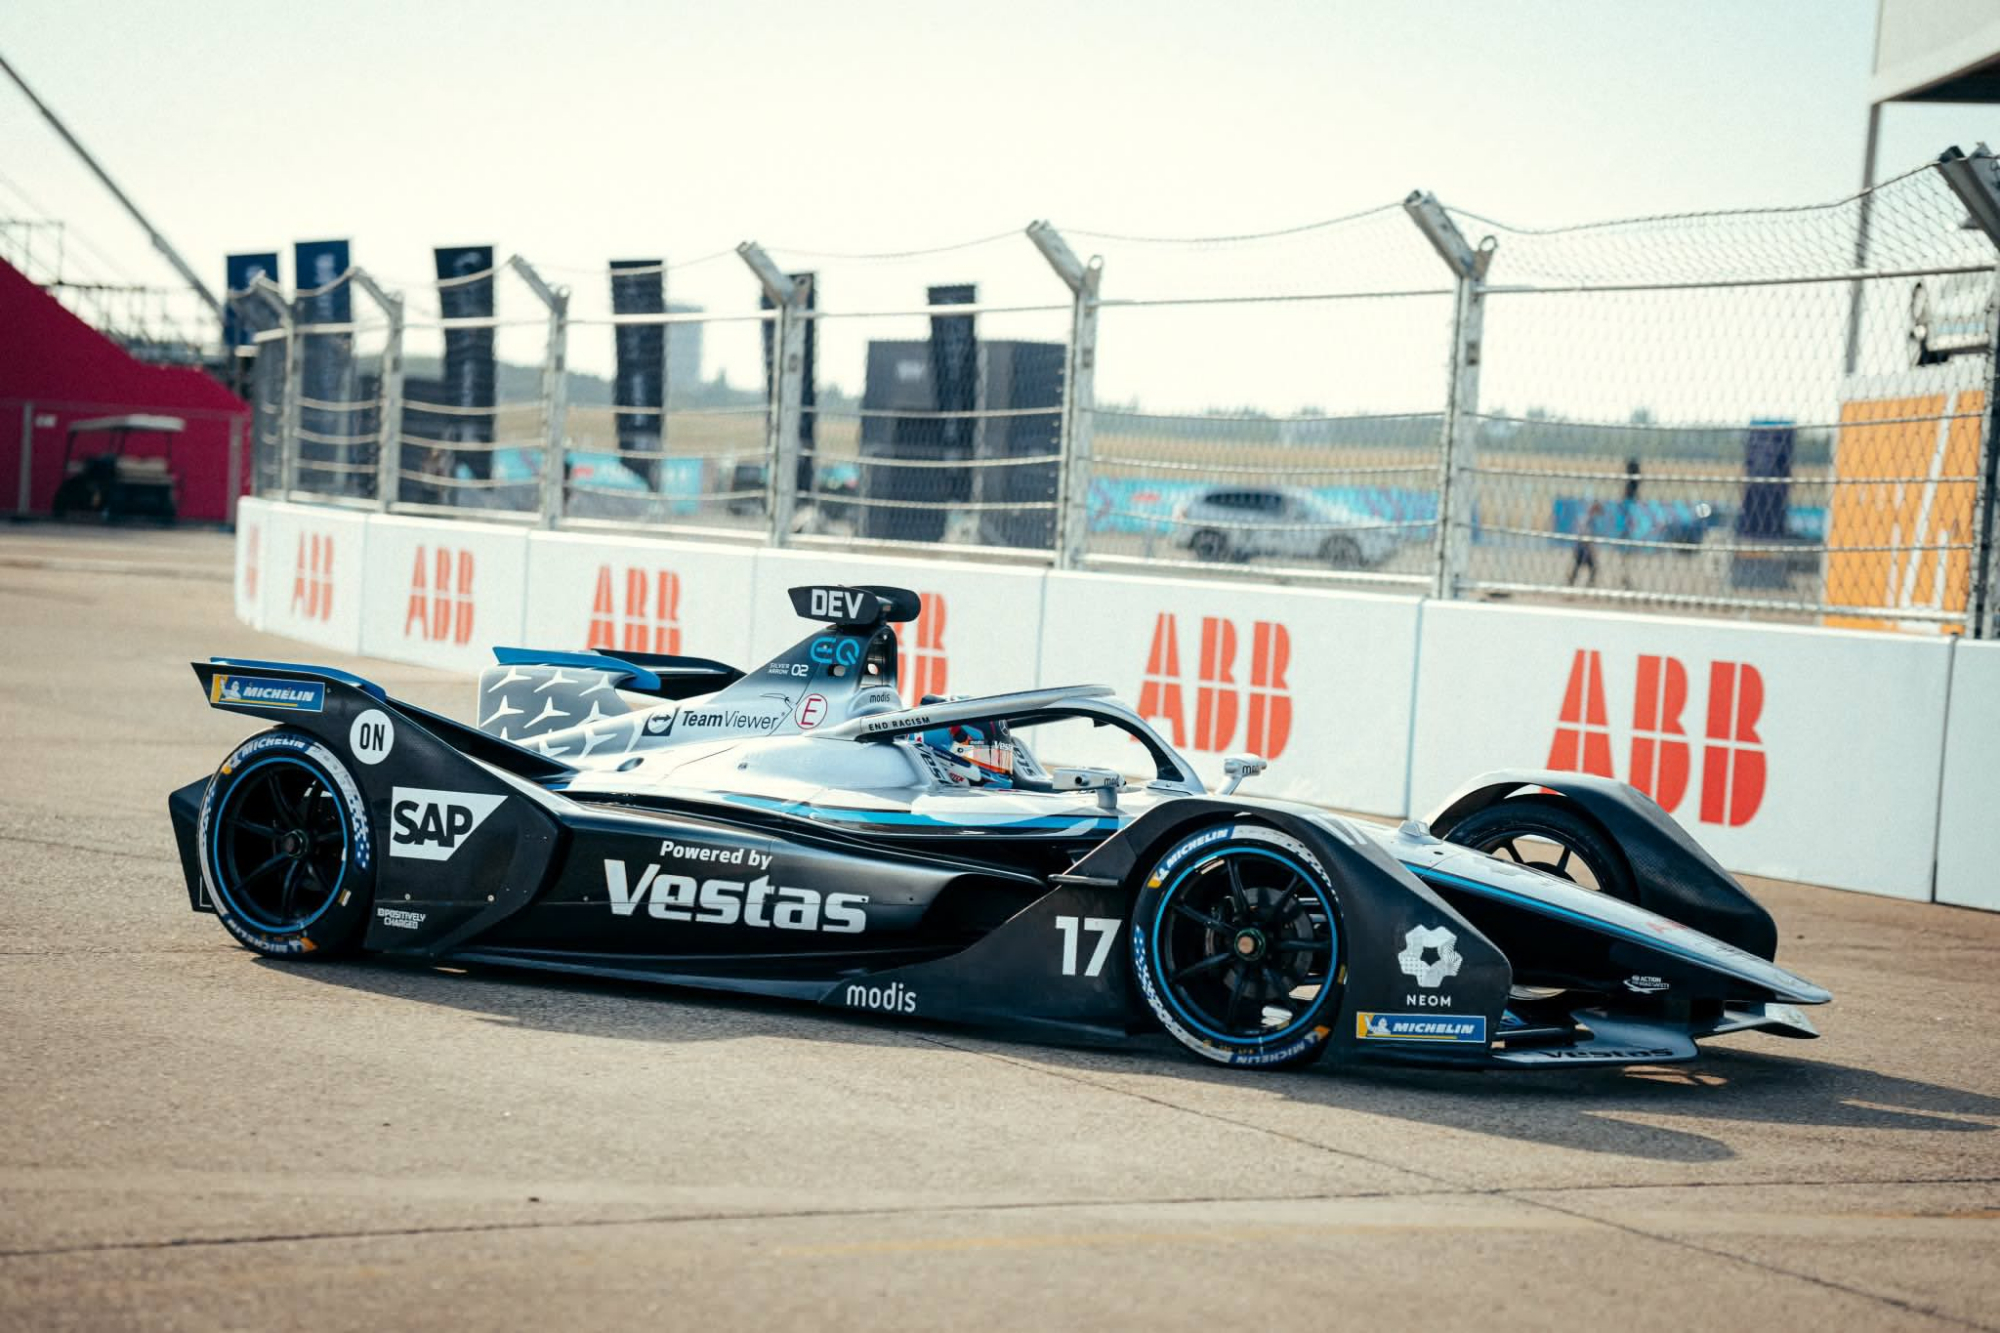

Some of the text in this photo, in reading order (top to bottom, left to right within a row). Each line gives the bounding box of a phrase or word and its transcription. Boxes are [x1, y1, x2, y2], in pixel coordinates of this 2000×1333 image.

[405, 546, 474, 645] ABB
[811, 588, 864, 619] DEV
[810, 637, 860, 666] EQ
[791, 663, 809, 677] 02
[243, 686, 315, 702] MICHELIN
[869, 692, 890, 704] modis
[1130, 612, 1293, 761] ABB
[682, 710, 778, 730] TeamViewer
[868, 716, 931, 731] END RACISM
[241, 737, 305, 757] MICHELIN
[360, 722, 385, 751] ON
[1538, 648, 1767, 828] ABB
[393, 800, 473, 848] SAP
[660, 840, 772, 871] Powered by
[1166, 828, 1229, 868] MICHELIN
[604, 858, 870, 934] Vestas
[1055, 915, 1122, 977] 17
[846, 982, 917, 1013] modis
[1406, 994, 1452, 1008] NEOM
[1393, 1022, 1475, 1035] MICHELIN
